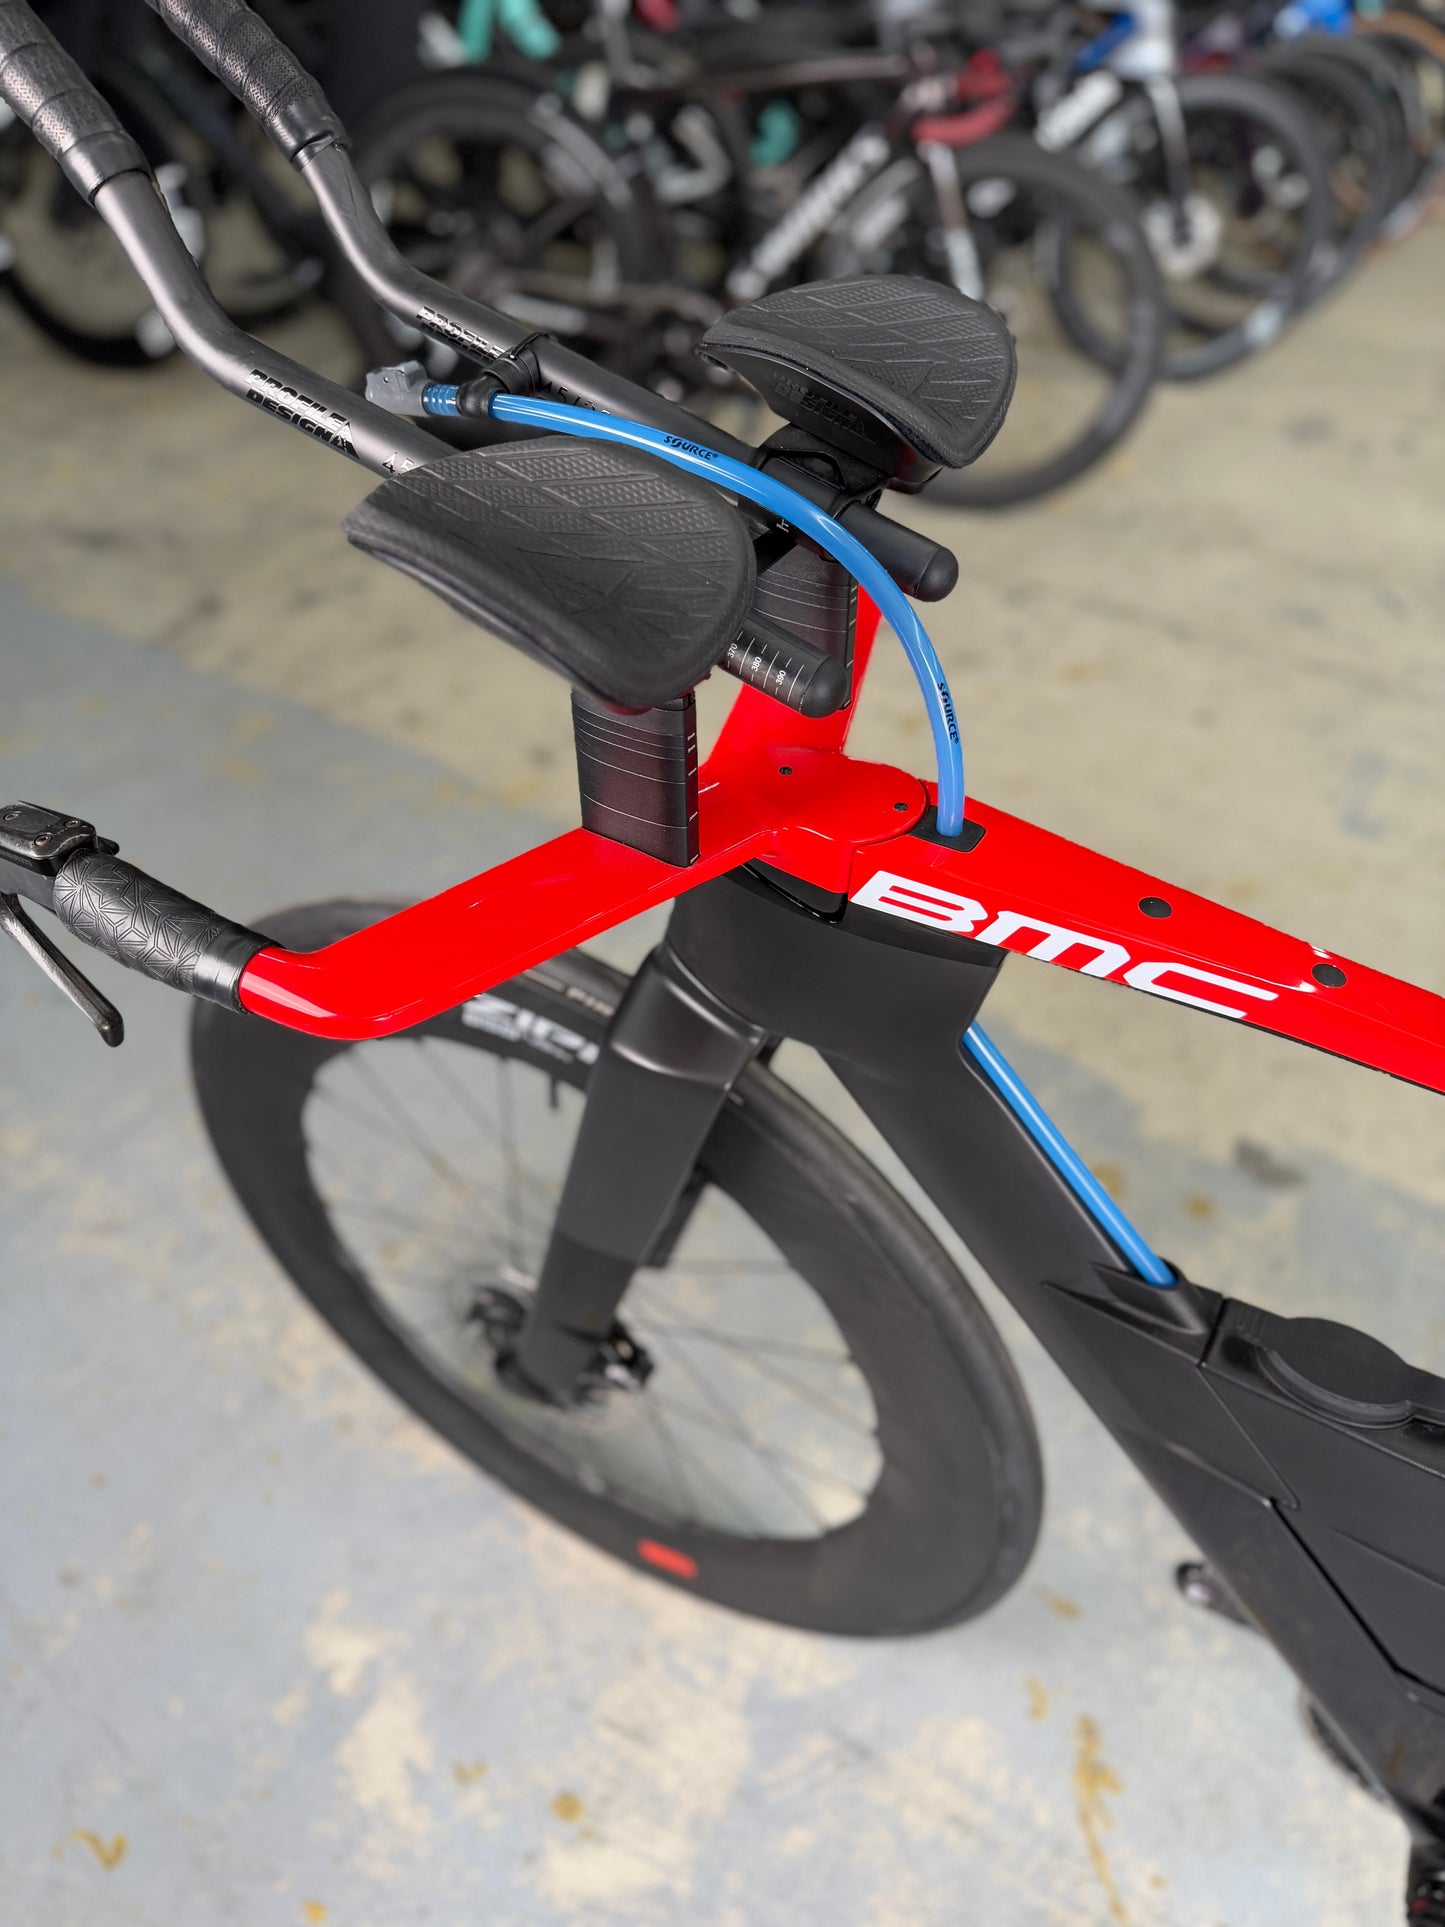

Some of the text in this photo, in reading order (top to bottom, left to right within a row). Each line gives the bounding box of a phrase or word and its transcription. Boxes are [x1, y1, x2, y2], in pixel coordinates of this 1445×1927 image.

[244, 369, 347, 432] PROFILE
[246, 388, 334, 443] DESIGN
[727, 643, 738, 659] 370
[751, 656, 762, 672] 380
[775, 670, 787, 685] 390
